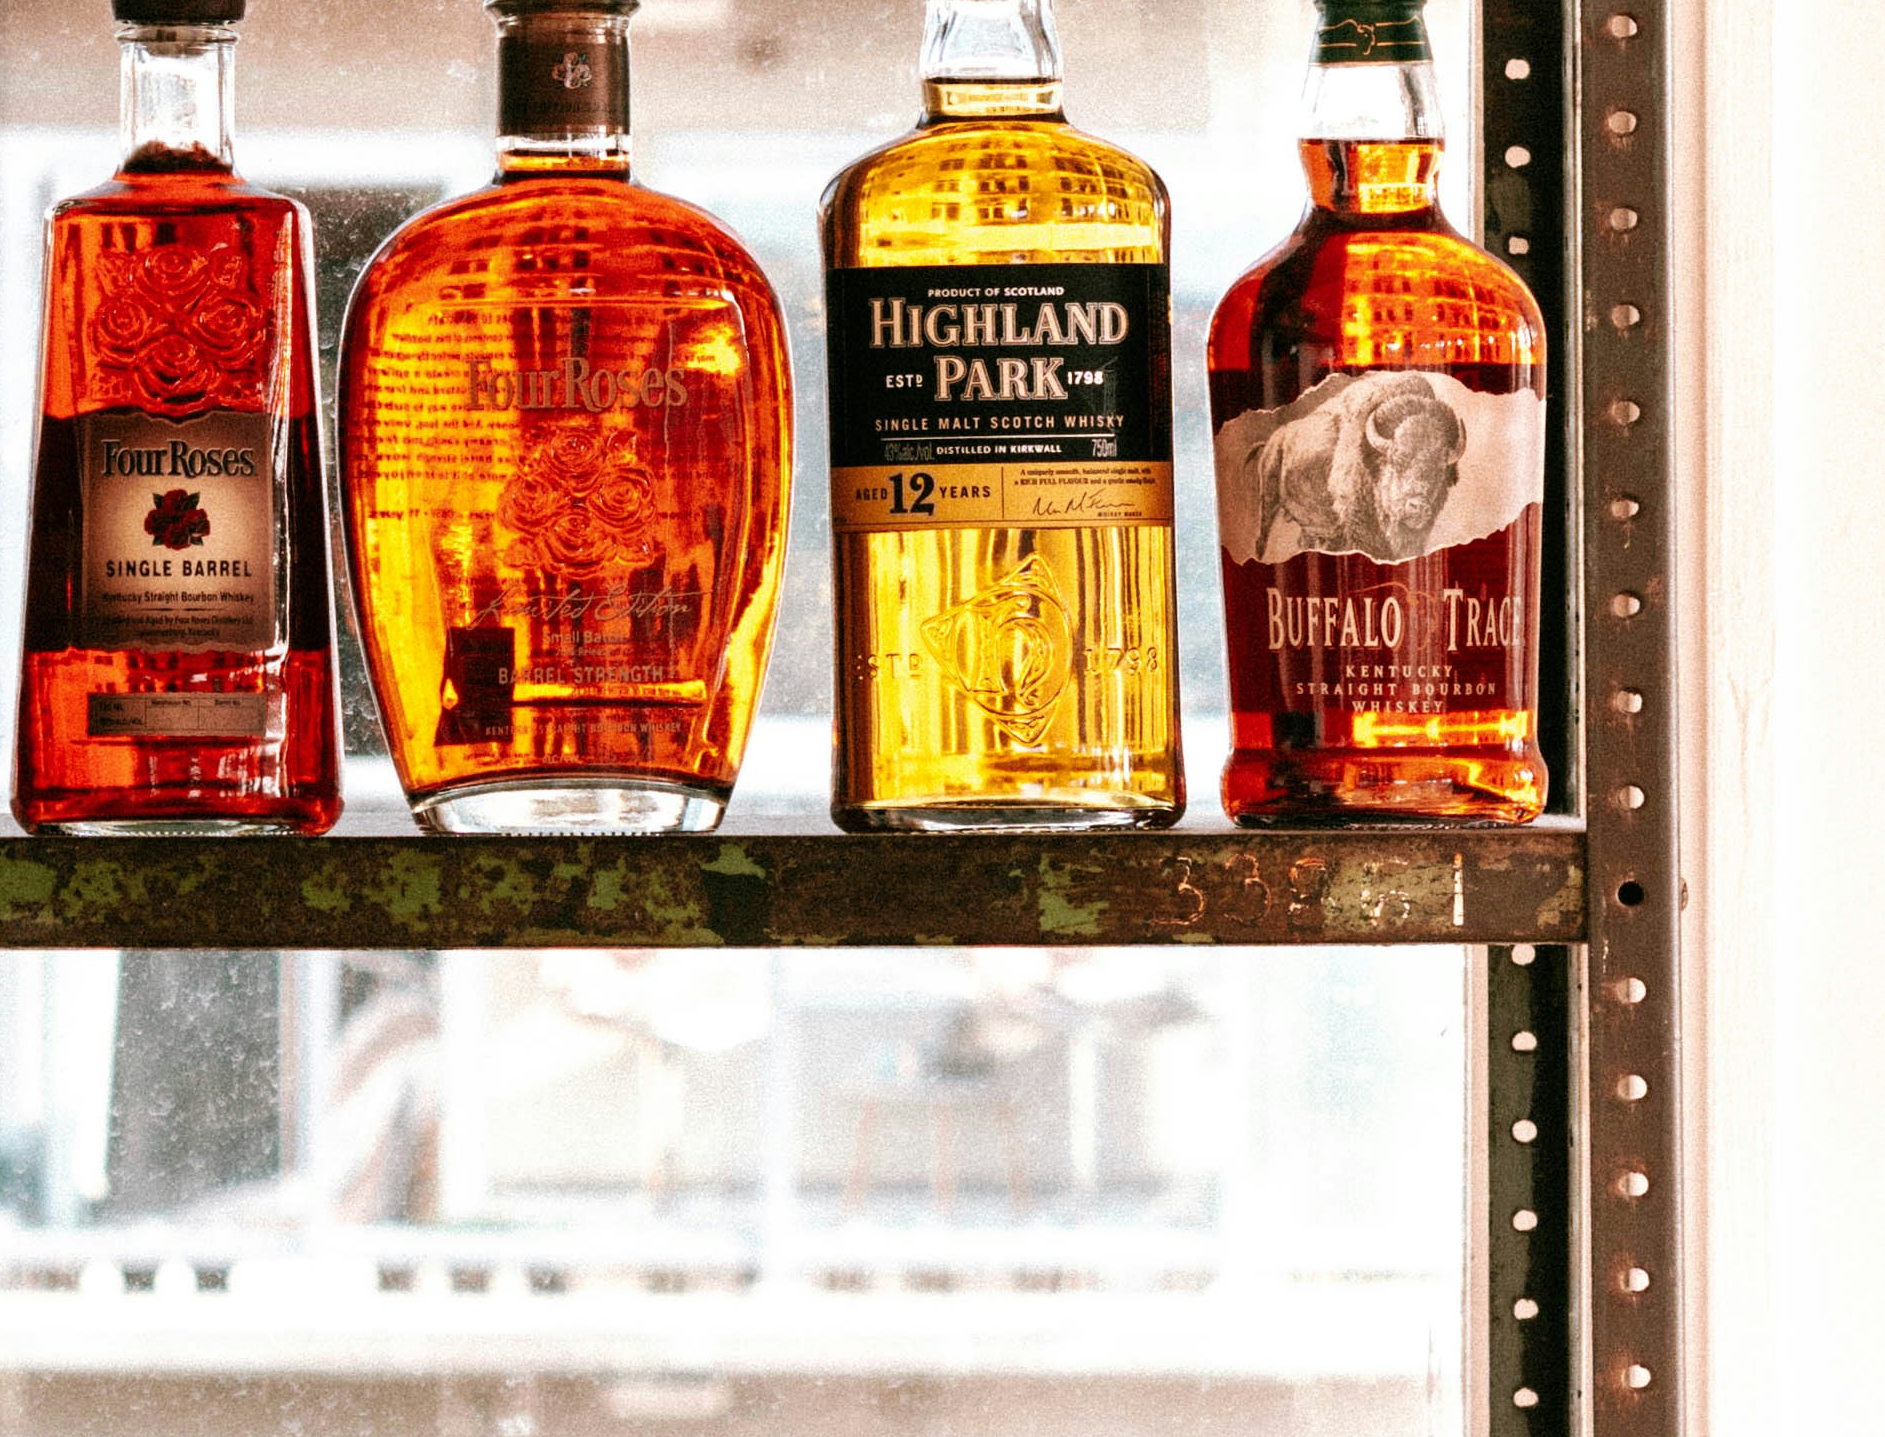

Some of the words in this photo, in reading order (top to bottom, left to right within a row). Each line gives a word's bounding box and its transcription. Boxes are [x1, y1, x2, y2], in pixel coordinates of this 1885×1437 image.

[928, 287, 981, 298] PRODUCT
[984, 287, 1001, 297] OF
[1004, 286, 1065, 297] SCOTLAND
[869, 296, 1130, 349] HIGHLAND
[467, 356, 562, 412] Four
[562, 356, 689, 414] Roses
[934, 355, 1069, 402] PARK
[1067, 370, 1104, 386] 1798
[875, 418, 929, 432] SINGLE
[938, 417, 981, 430] MALT
[990, 415, 1055, 429] SCOTCH
[1064, 415, 1126, 429] WHISKY
[100, 439, 166, 476] Four
[166, 439, 255, 478] Roses
[855, 486, 888, 501] AGED
[888, 472, 935, 516] 12
[939, 485, 992, 499] YEARS
[106, 560, 172, 577] SINGLE
[182, 560, 252, 577] BARREL
[1267, 588, 1402, 651] BUFFALO
[1443, 588, 1526, 652] TRACE
[498, 668, 566, 684] BARREL
[573, 667, 665, 682] STRENGTH
[1345, 665, 1453, 679] KENTUCKY
[1296, 682, 1398, 696] STRAIGHT
[1412, 682, 1497, 696] BOURBON
[1351, 699, 1445, 715] WHISKEY
